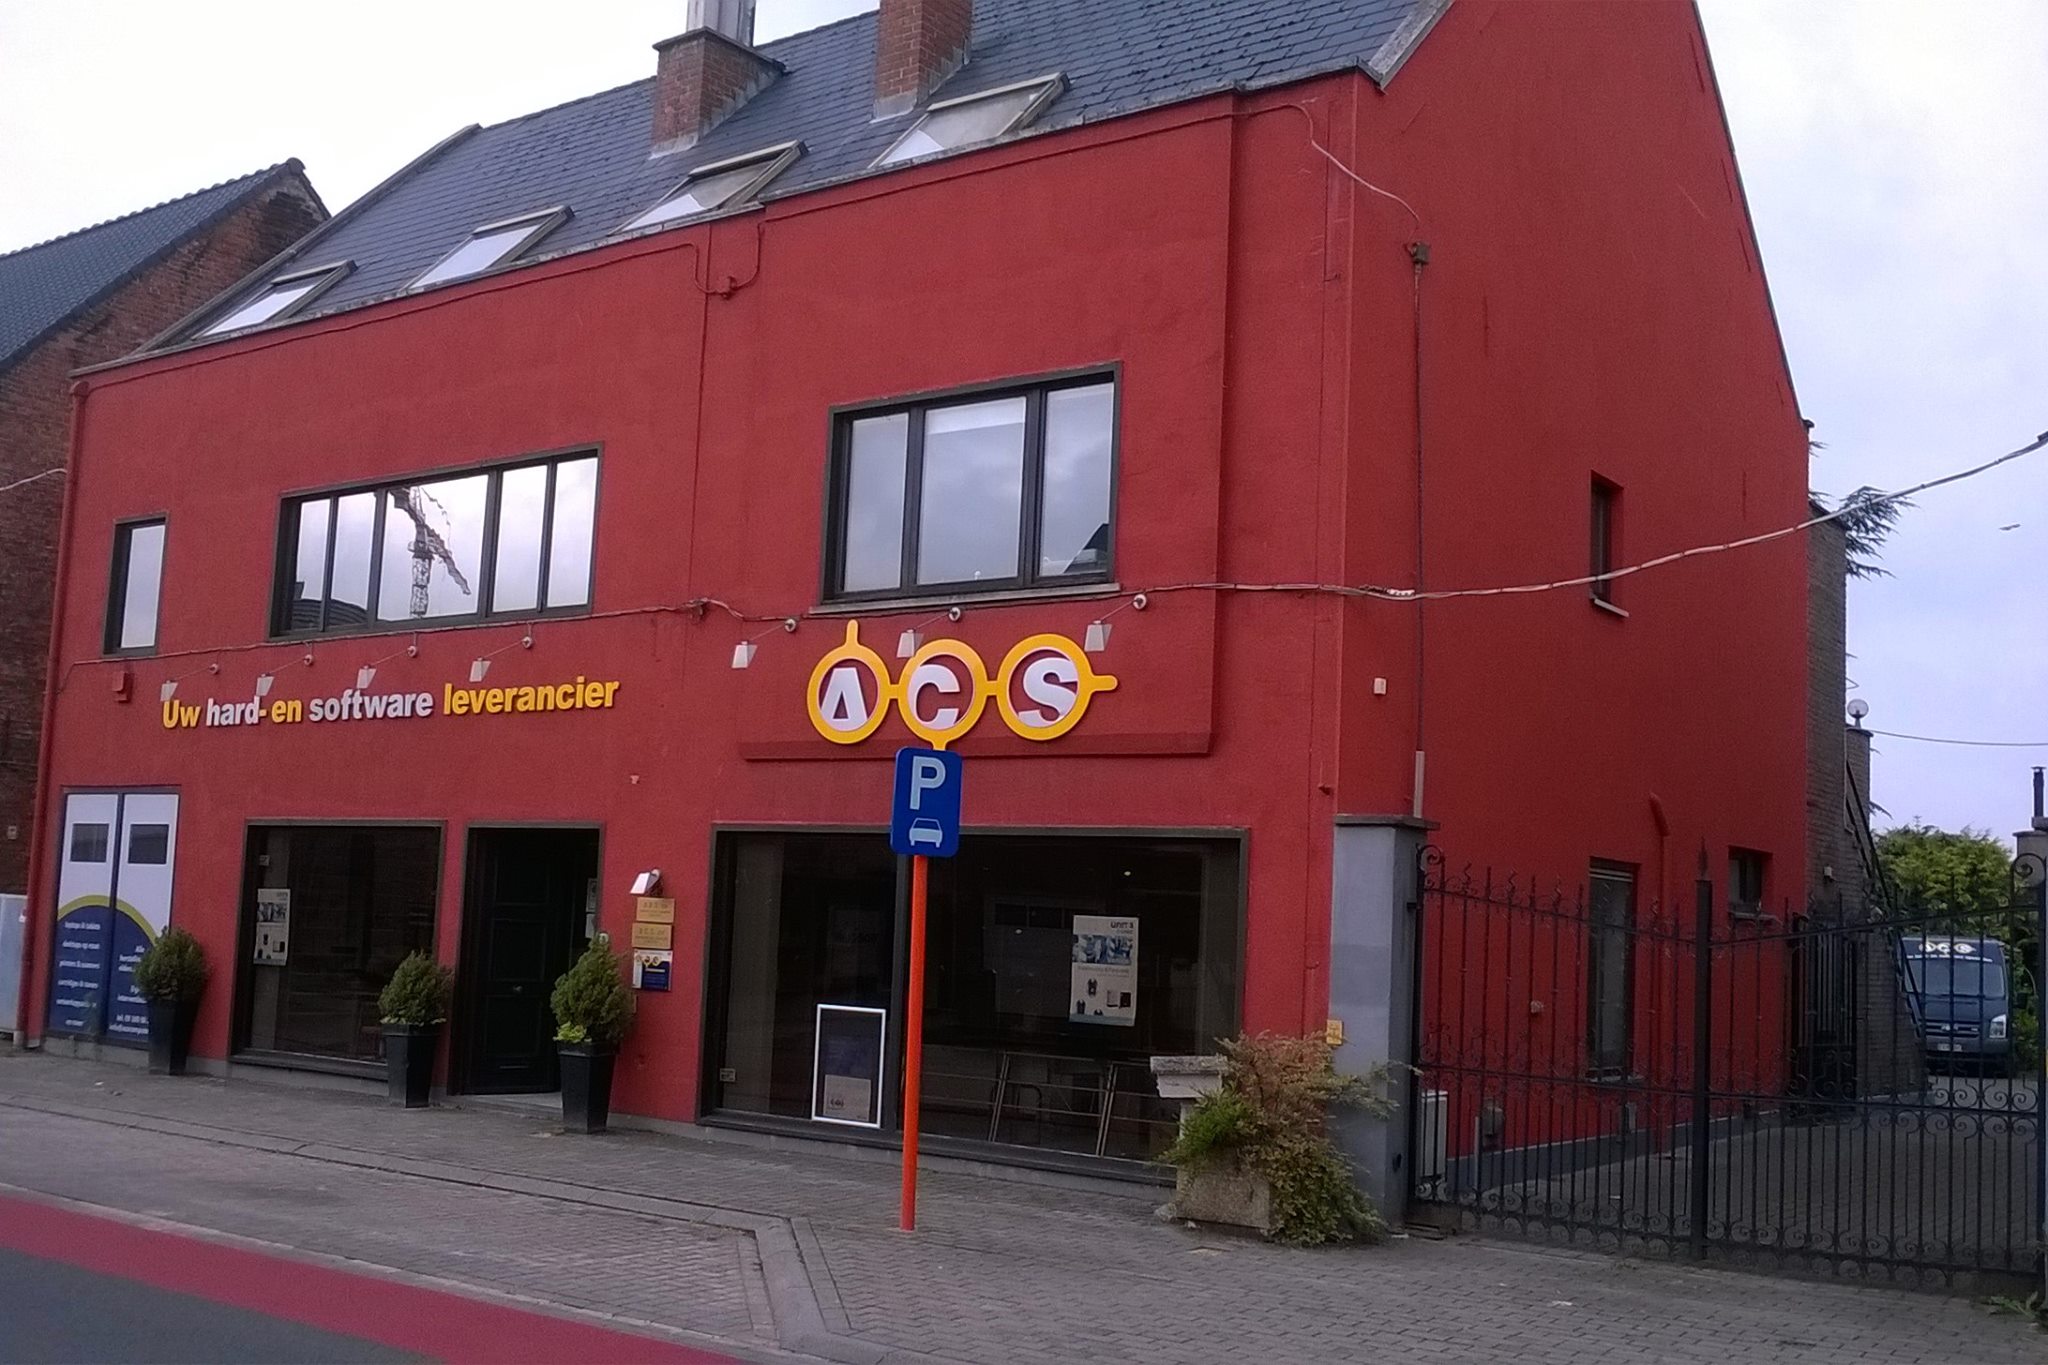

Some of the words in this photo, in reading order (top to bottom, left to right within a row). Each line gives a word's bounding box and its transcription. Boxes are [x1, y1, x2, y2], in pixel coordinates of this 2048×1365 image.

[162, 699, 201, 728] Uw
[309, 688, 434, 722] software
[443, 676, 620, 715] leverancier
[819, 657, 1078, 732] ACS
[909, 756, 946, 810] P
